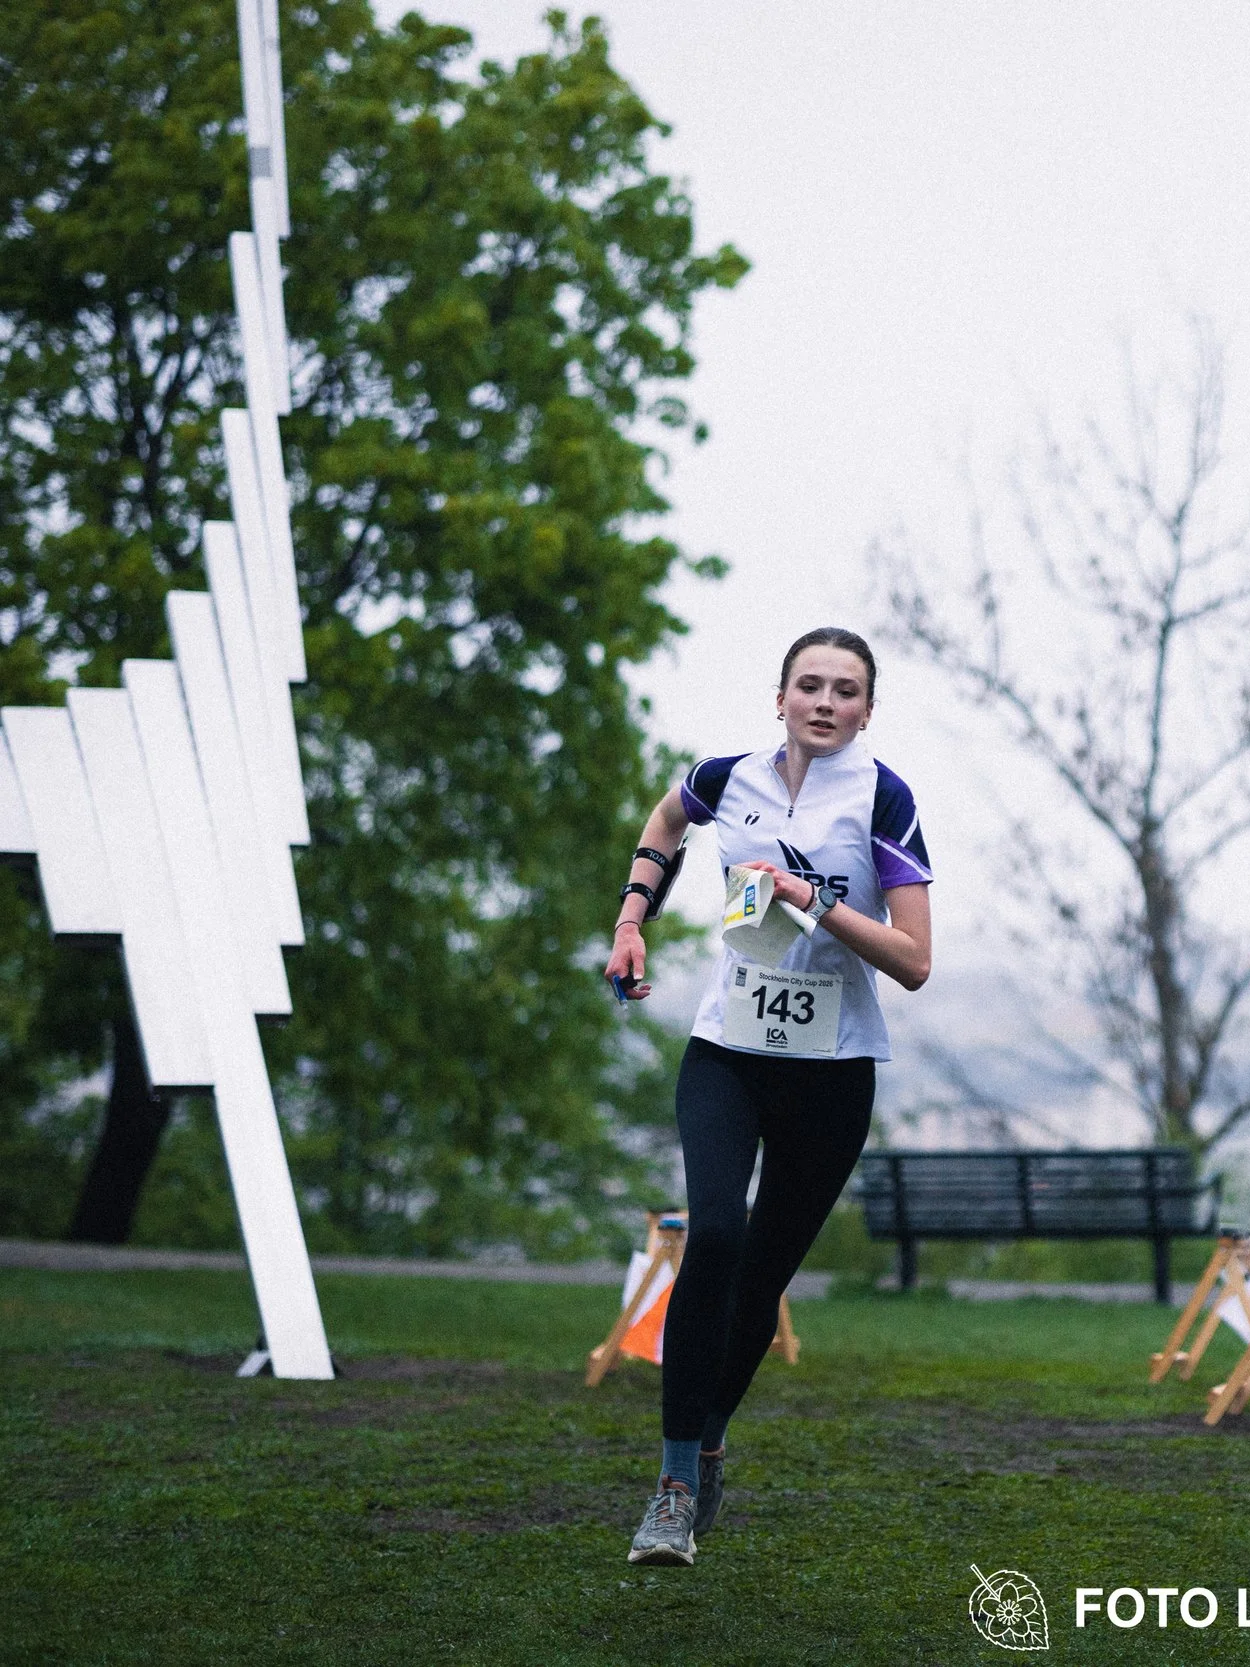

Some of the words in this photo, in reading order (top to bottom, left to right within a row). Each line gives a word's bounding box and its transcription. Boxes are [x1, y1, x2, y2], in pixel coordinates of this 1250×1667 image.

[758, 972, 790, 983] Stockholm
[790, 977, 803, 987] City
[804, 979, 818, 987] Cup
[751, 985, 815, 1025] 143
[766, 1027, 788, 1040] ICA
